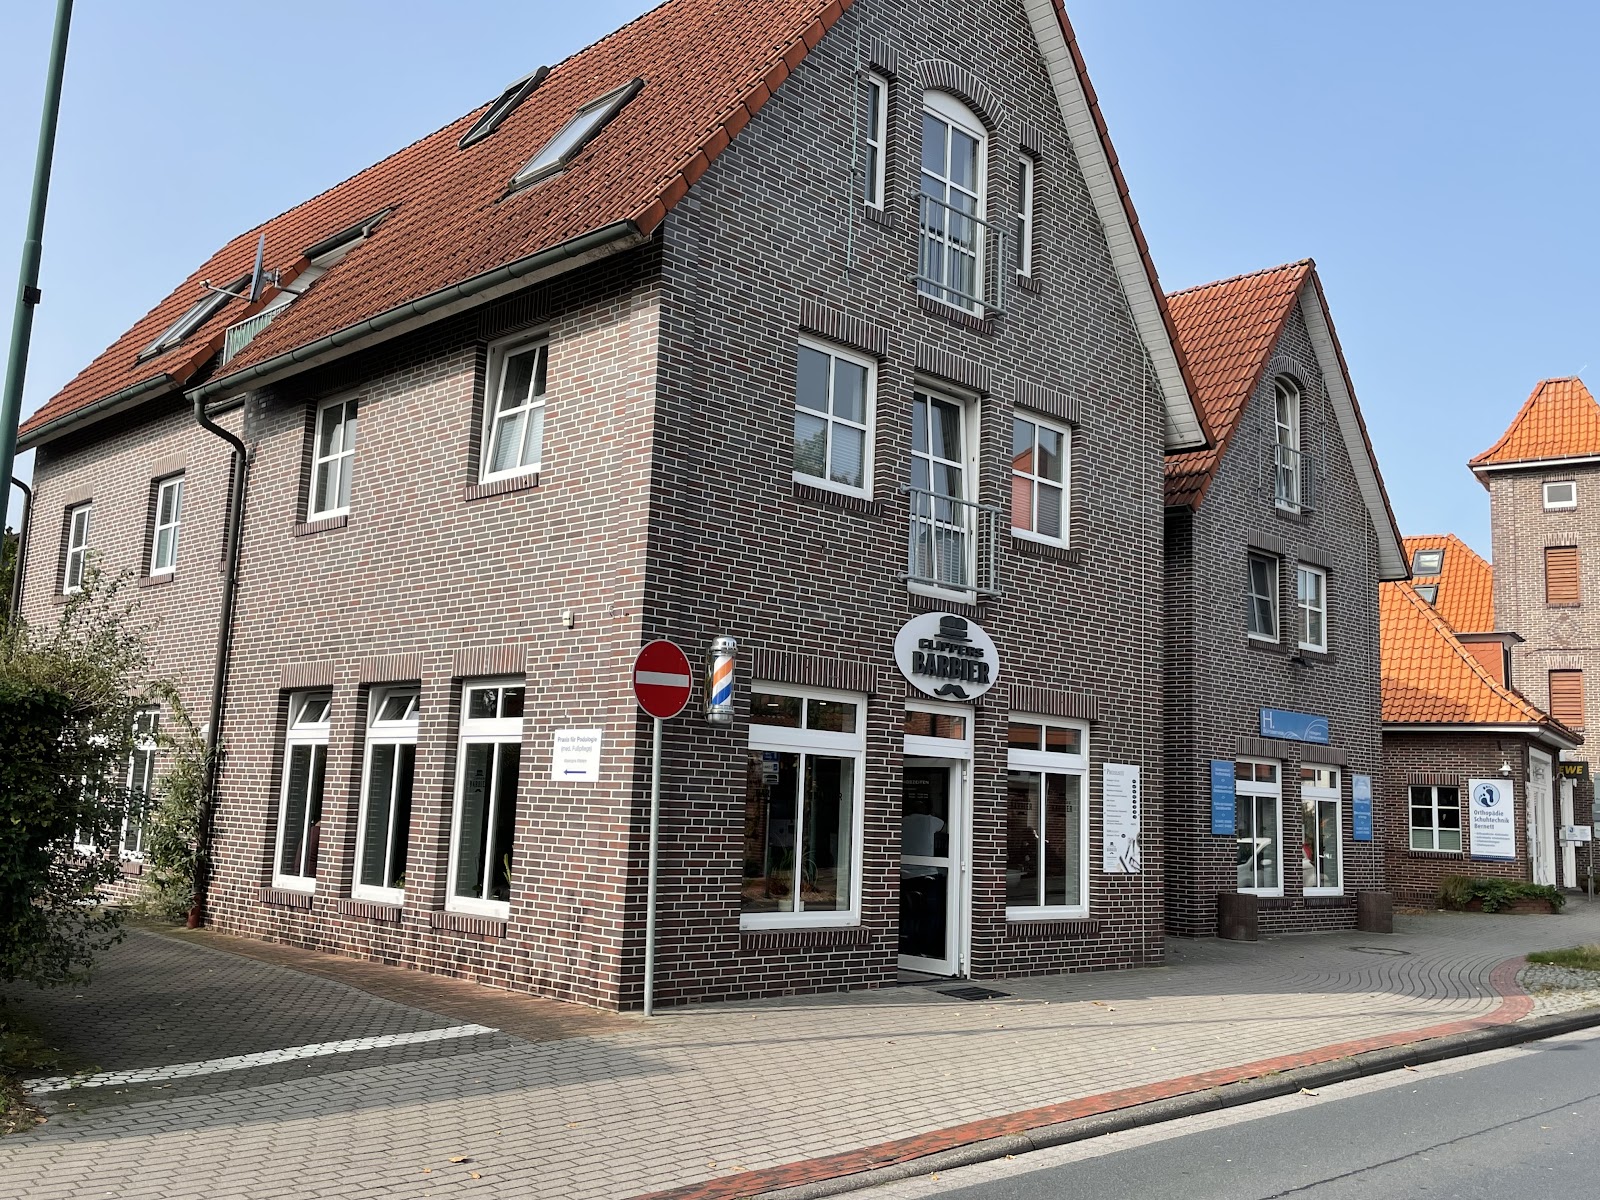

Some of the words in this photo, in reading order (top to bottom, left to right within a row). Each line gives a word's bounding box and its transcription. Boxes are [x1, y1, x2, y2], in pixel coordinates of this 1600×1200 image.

[918, 638, 984, 658] CLIPPERS
[912, 651, 990, 684] BARBIER
[1473, 809, 1504, 817] Orthopädie
